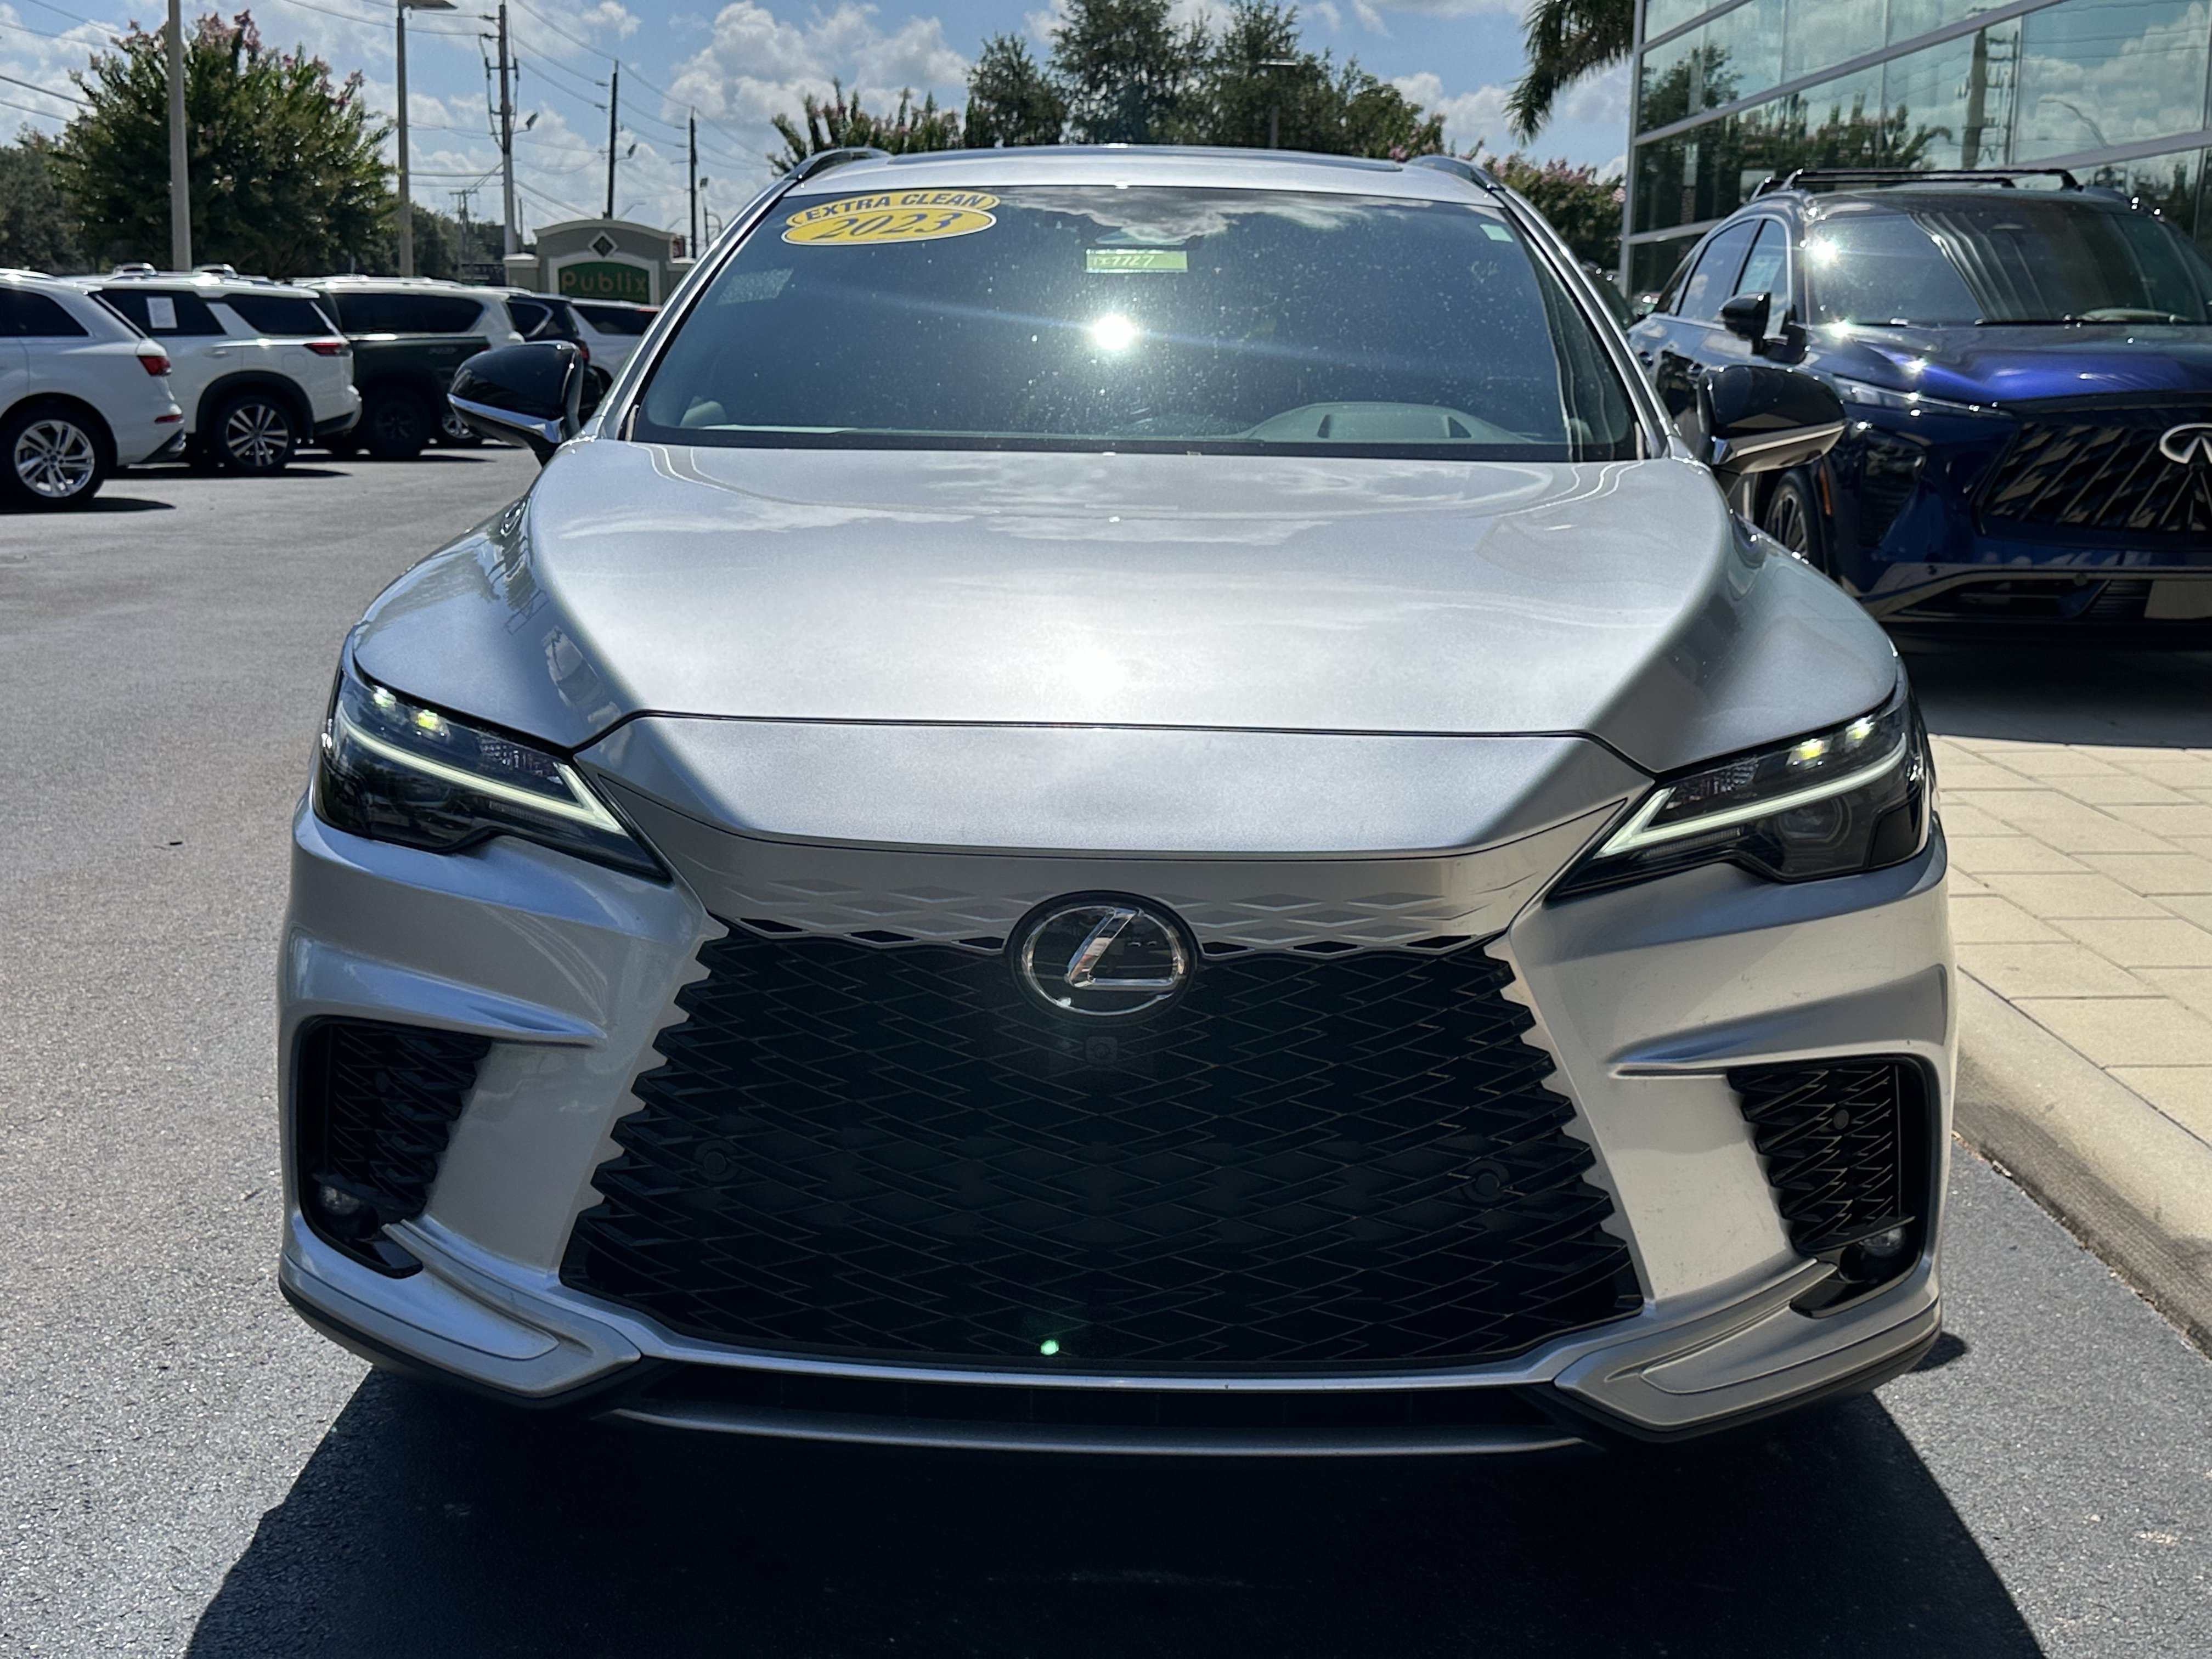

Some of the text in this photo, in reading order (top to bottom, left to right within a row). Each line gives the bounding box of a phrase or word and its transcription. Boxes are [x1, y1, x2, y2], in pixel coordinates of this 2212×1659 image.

[806, 194, 988, 222] EXTRA CLEAN
[812, 212, 963, 240] 2023
[561, 270, 646, 293] Publix
